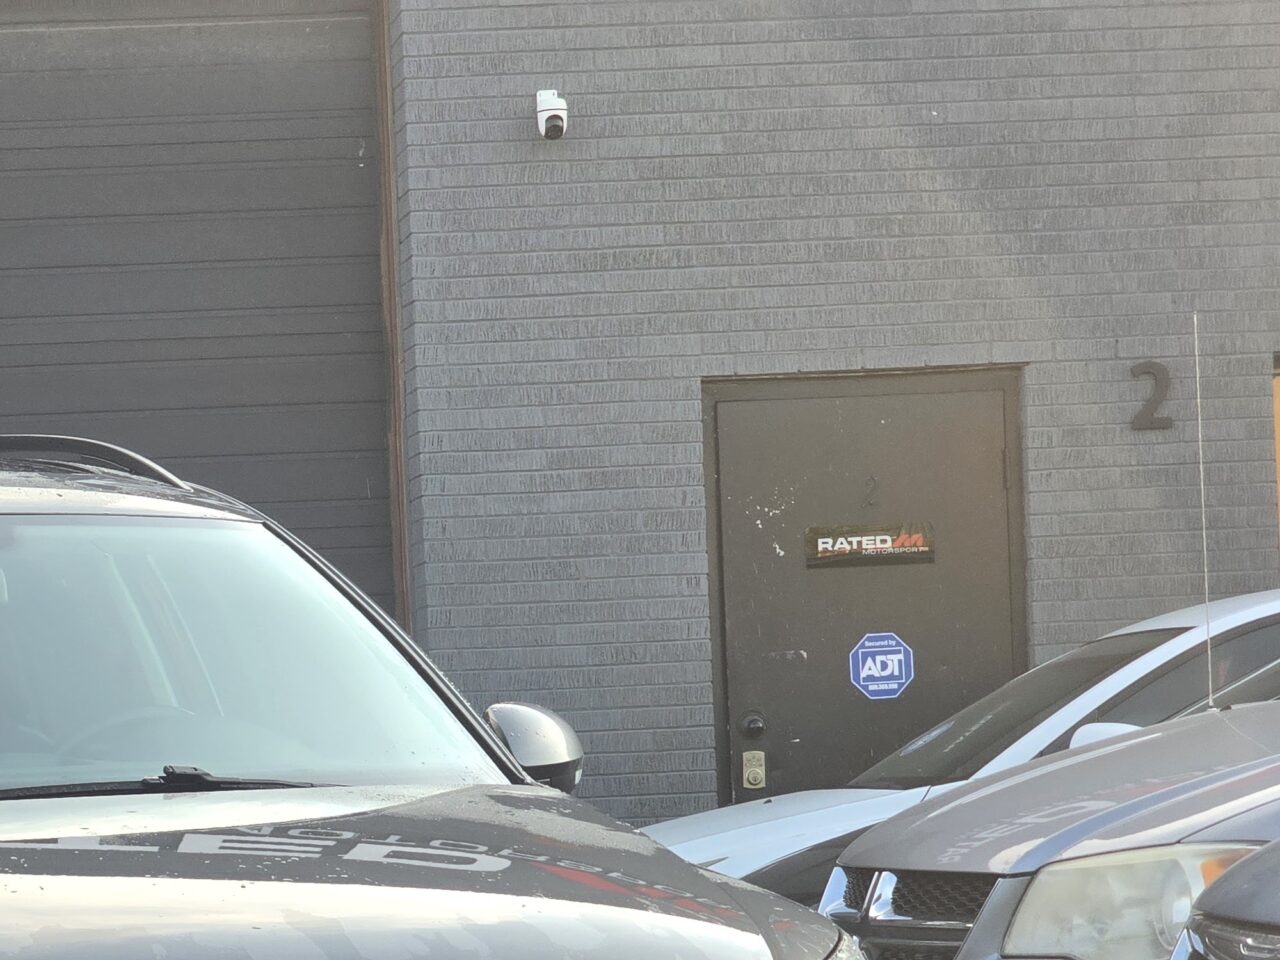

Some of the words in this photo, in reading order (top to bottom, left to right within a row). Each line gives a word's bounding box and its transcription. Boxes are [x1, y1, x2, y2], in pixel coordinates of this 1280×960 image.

[1130, 360, 1172, 430] 2
[817, 535, 892, 552] RATED
[861, 653, 904, 678] ADT
